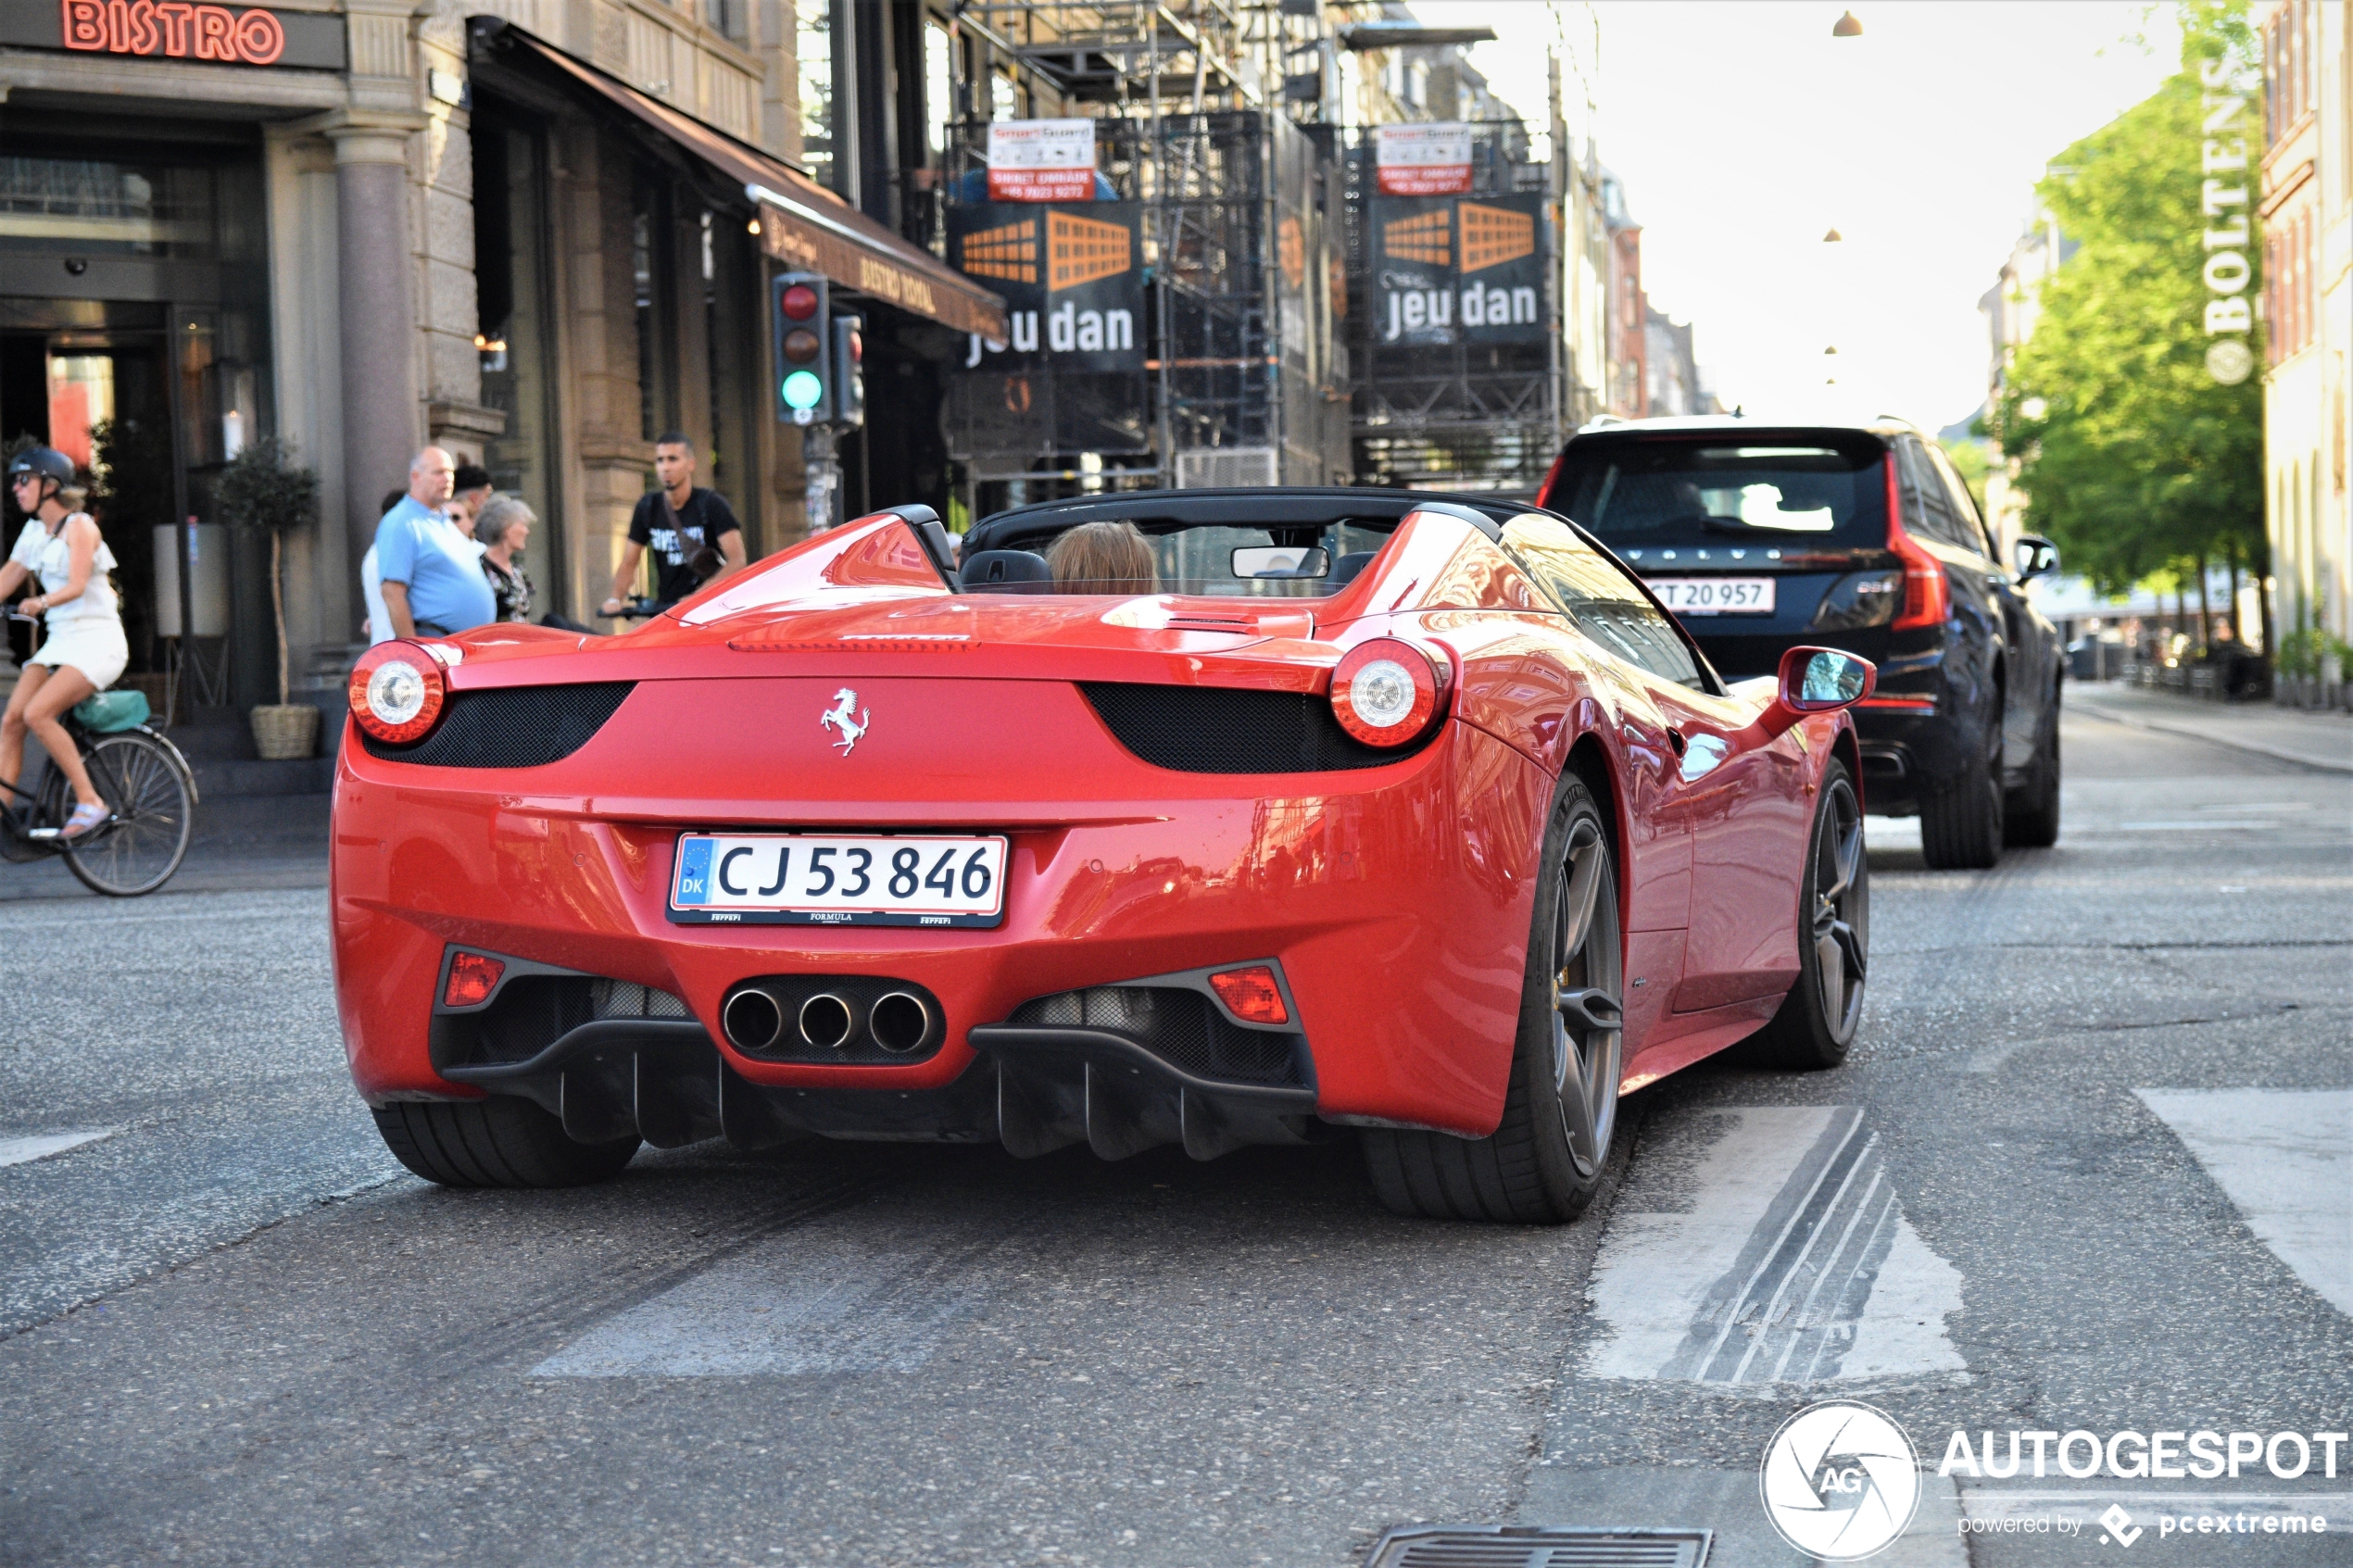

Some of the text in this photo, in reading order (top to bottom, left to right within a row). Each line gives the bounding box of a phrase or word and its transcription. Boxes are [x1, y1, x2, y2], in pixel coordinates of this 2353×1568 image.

[62, 0, 284, 65] BISTRO
[2202, 58, 2251, 335] BOLTENS
[1627, 548, 1781, 560] VOLVO
[1686, 584, 1713, 604] 20
[1720, 584, 1762, 605] 957
[718, 847, 991, 898] CJ 53 846
[682, 879, 703, 894] DK
[810, 912, 852, 921] FORMULA
